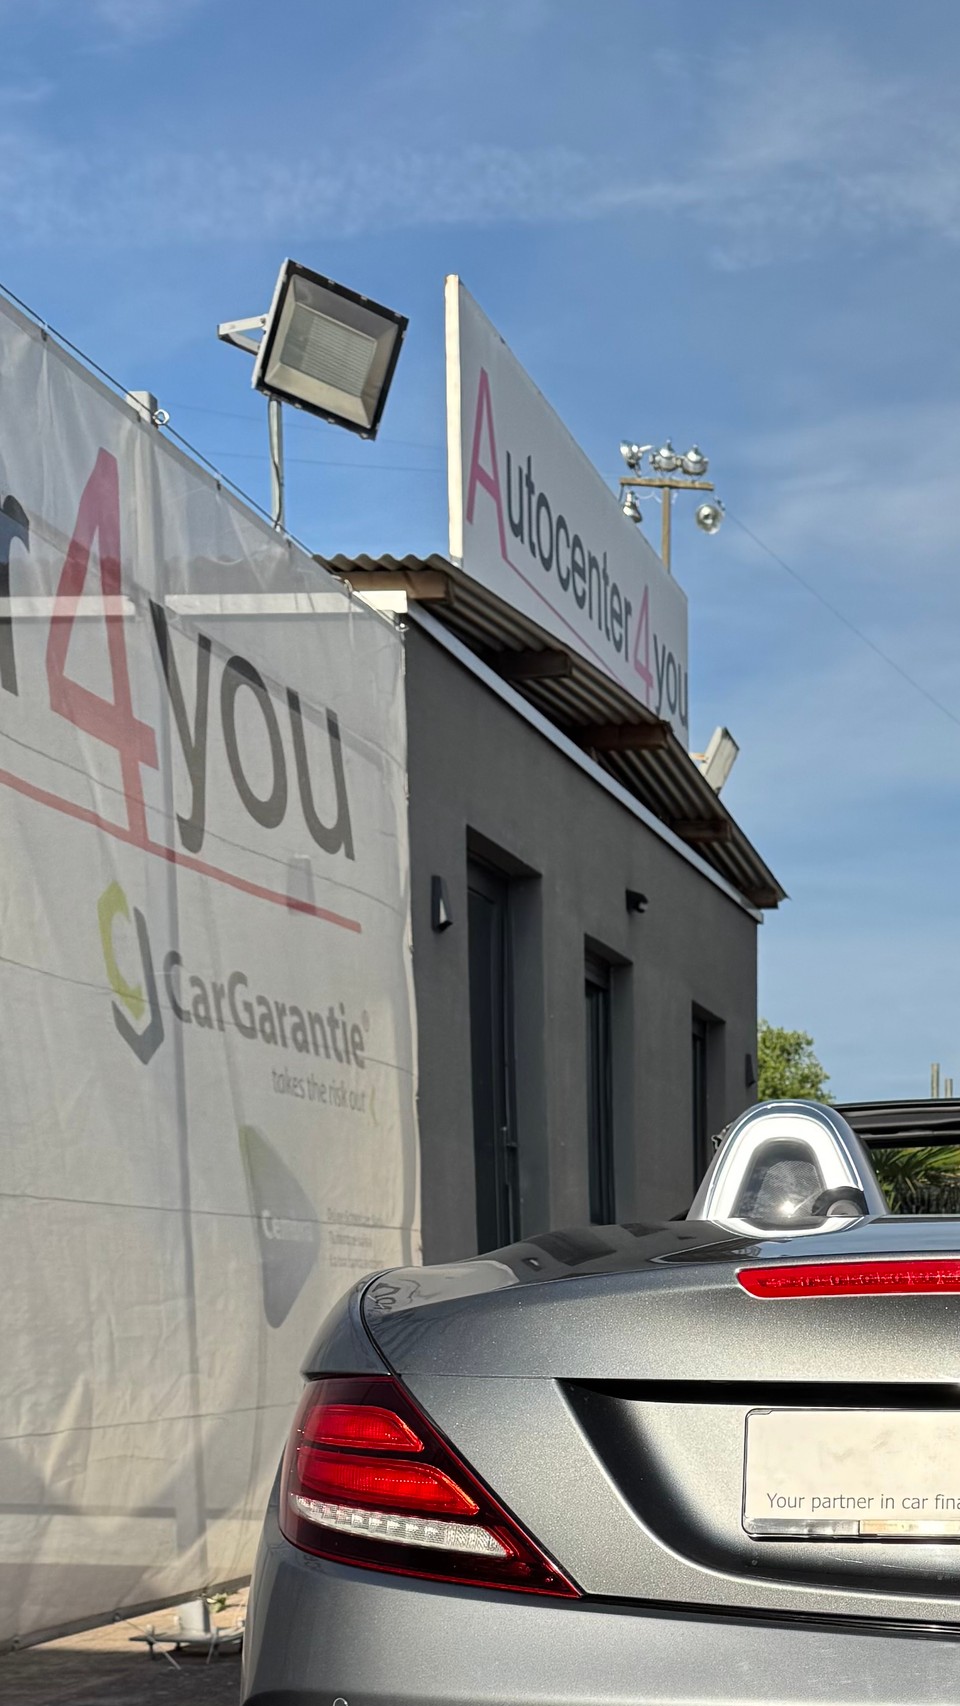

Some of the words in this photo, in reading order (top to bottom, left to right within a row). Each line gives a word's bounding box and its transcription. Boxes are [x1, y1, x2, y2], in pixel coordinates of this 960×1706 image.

[466, 366, 688, 729] Autocenter4you
[271, 1066, 305, 1100] takes
[306, 1073, 327, 1104] the
[766, 1493, 805, 1509] Your
[811, 1494, 875, 1512] partner
[880, 1494, 895, 1510] in
[901, 1496, 929, 1510] car
